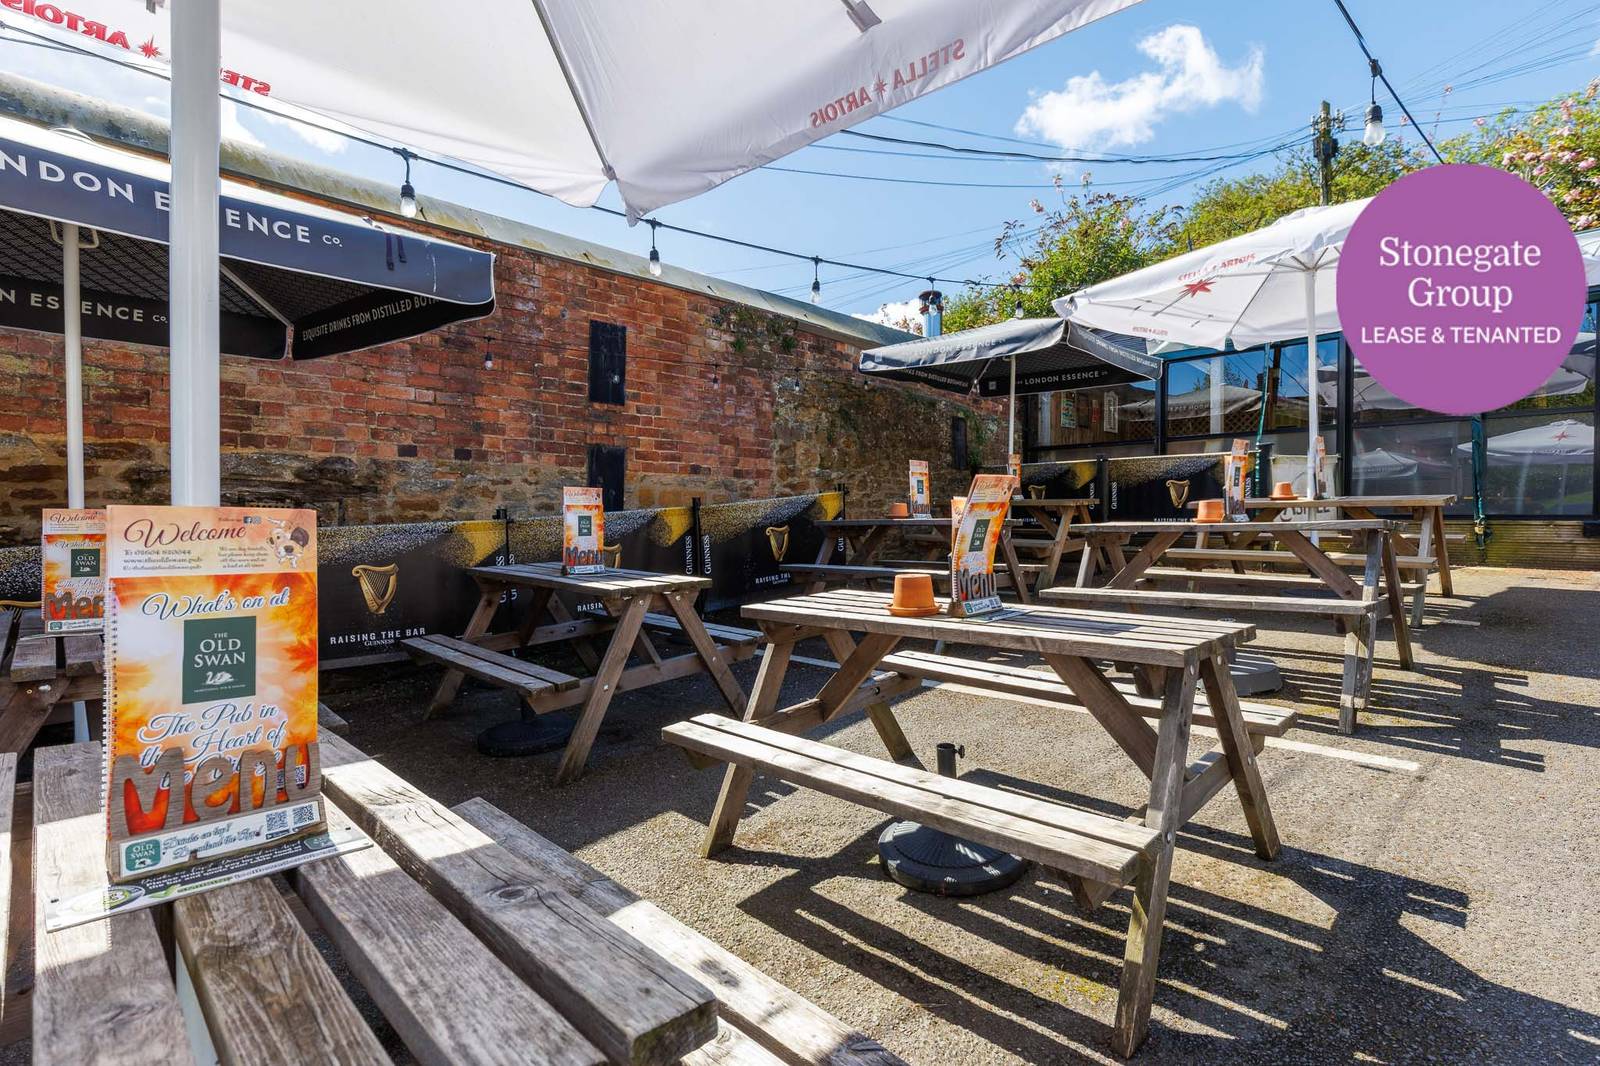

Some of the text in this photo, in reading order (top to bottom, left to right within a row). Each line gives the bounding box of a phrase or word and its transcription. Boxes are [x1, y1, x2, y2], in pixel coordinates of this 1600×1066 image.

[0, 152, 135, 204] NDON
[154, 190, 311, 244] EENCE
[30, 292, 144, 323] ESENCE
[329, 316, 351, 333] DRINKS
[351, 311, 371, 327] FROM
[371, 298, 413, 320] DISTILLED
[1024, 375, 1059, 385] LONDON
[1061, 370, 1100, 381] ESSENCE
[124, 518, 247, 549] Welcome
[685, 535, 693, 575] GUINNESS
[703, 534, 712, 574] GUINNESS
[142, 587, 290, 620] What's on at
[200, 638, 241, 653] OLD
[330, 627, 426, 645] RAISING THE BAR
[364, 638, 395, 647] GUINNESS
[194, 651, 246, 668] SWAN
[138, 702, 277, 744] The Pub in
[184, 726, 262, 764] Heart
[266, 720, 287, 748] of
[110, 743, 321, 839] Menu
[131, 849, 156, 859] SWAN
[132, 843, 154, 853] OLD
